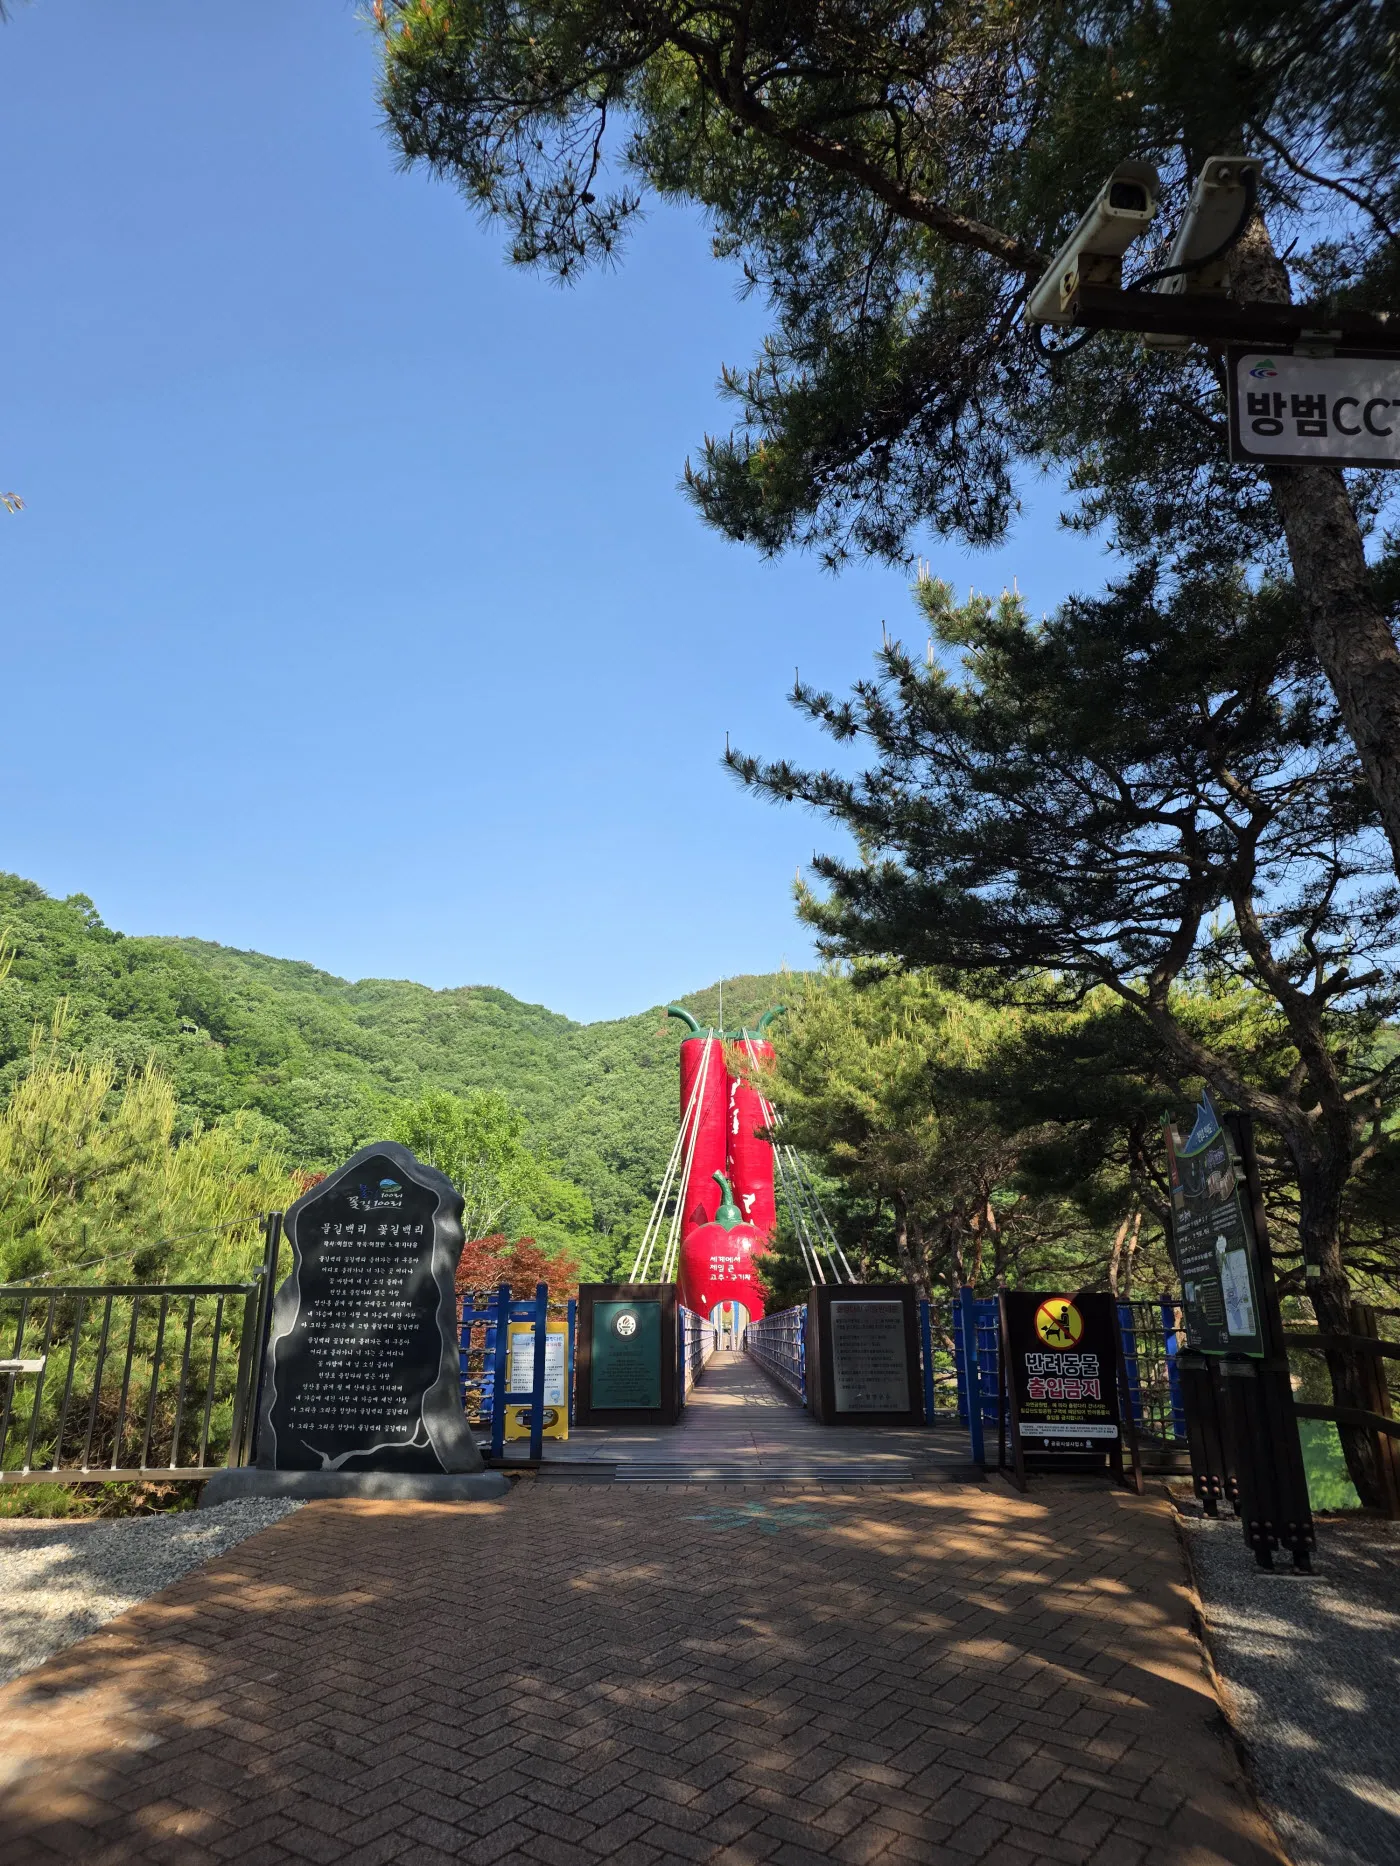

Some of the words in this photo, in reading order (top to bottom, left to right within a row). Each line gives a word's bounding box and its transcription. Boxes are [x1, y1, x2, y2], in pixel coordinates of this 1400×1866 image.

[1246, 392, 1400, 437] 방범CC
[321, 1223, 366, 1234] 물길백리
[378, 1224, 423, 1235] 꽃길백리
[710, 1264, 724, 1272] 제일
[728, 1265, 734, 1273] 큰
[1025, 1353, 1099, 1376] 반려동물
[1027, 1377, 1101, 1400] 출입금지
